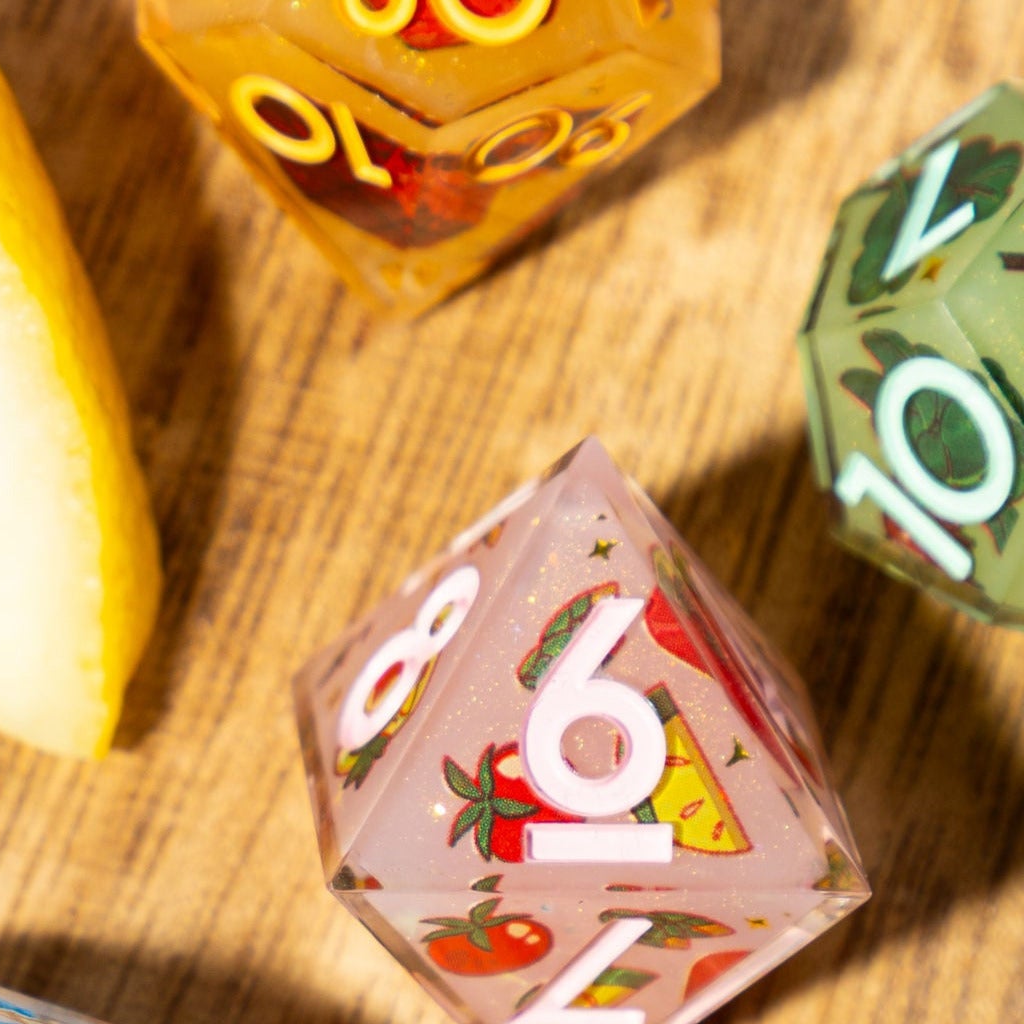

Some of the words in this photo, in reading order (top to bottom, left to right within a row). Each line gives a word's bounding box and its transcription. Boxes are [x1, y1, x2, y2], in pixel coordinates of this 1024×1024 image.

[835, 355, 1014, 581] 10
[337, 564, 480, 751] 8
[520, 598, 675, 864] 6
